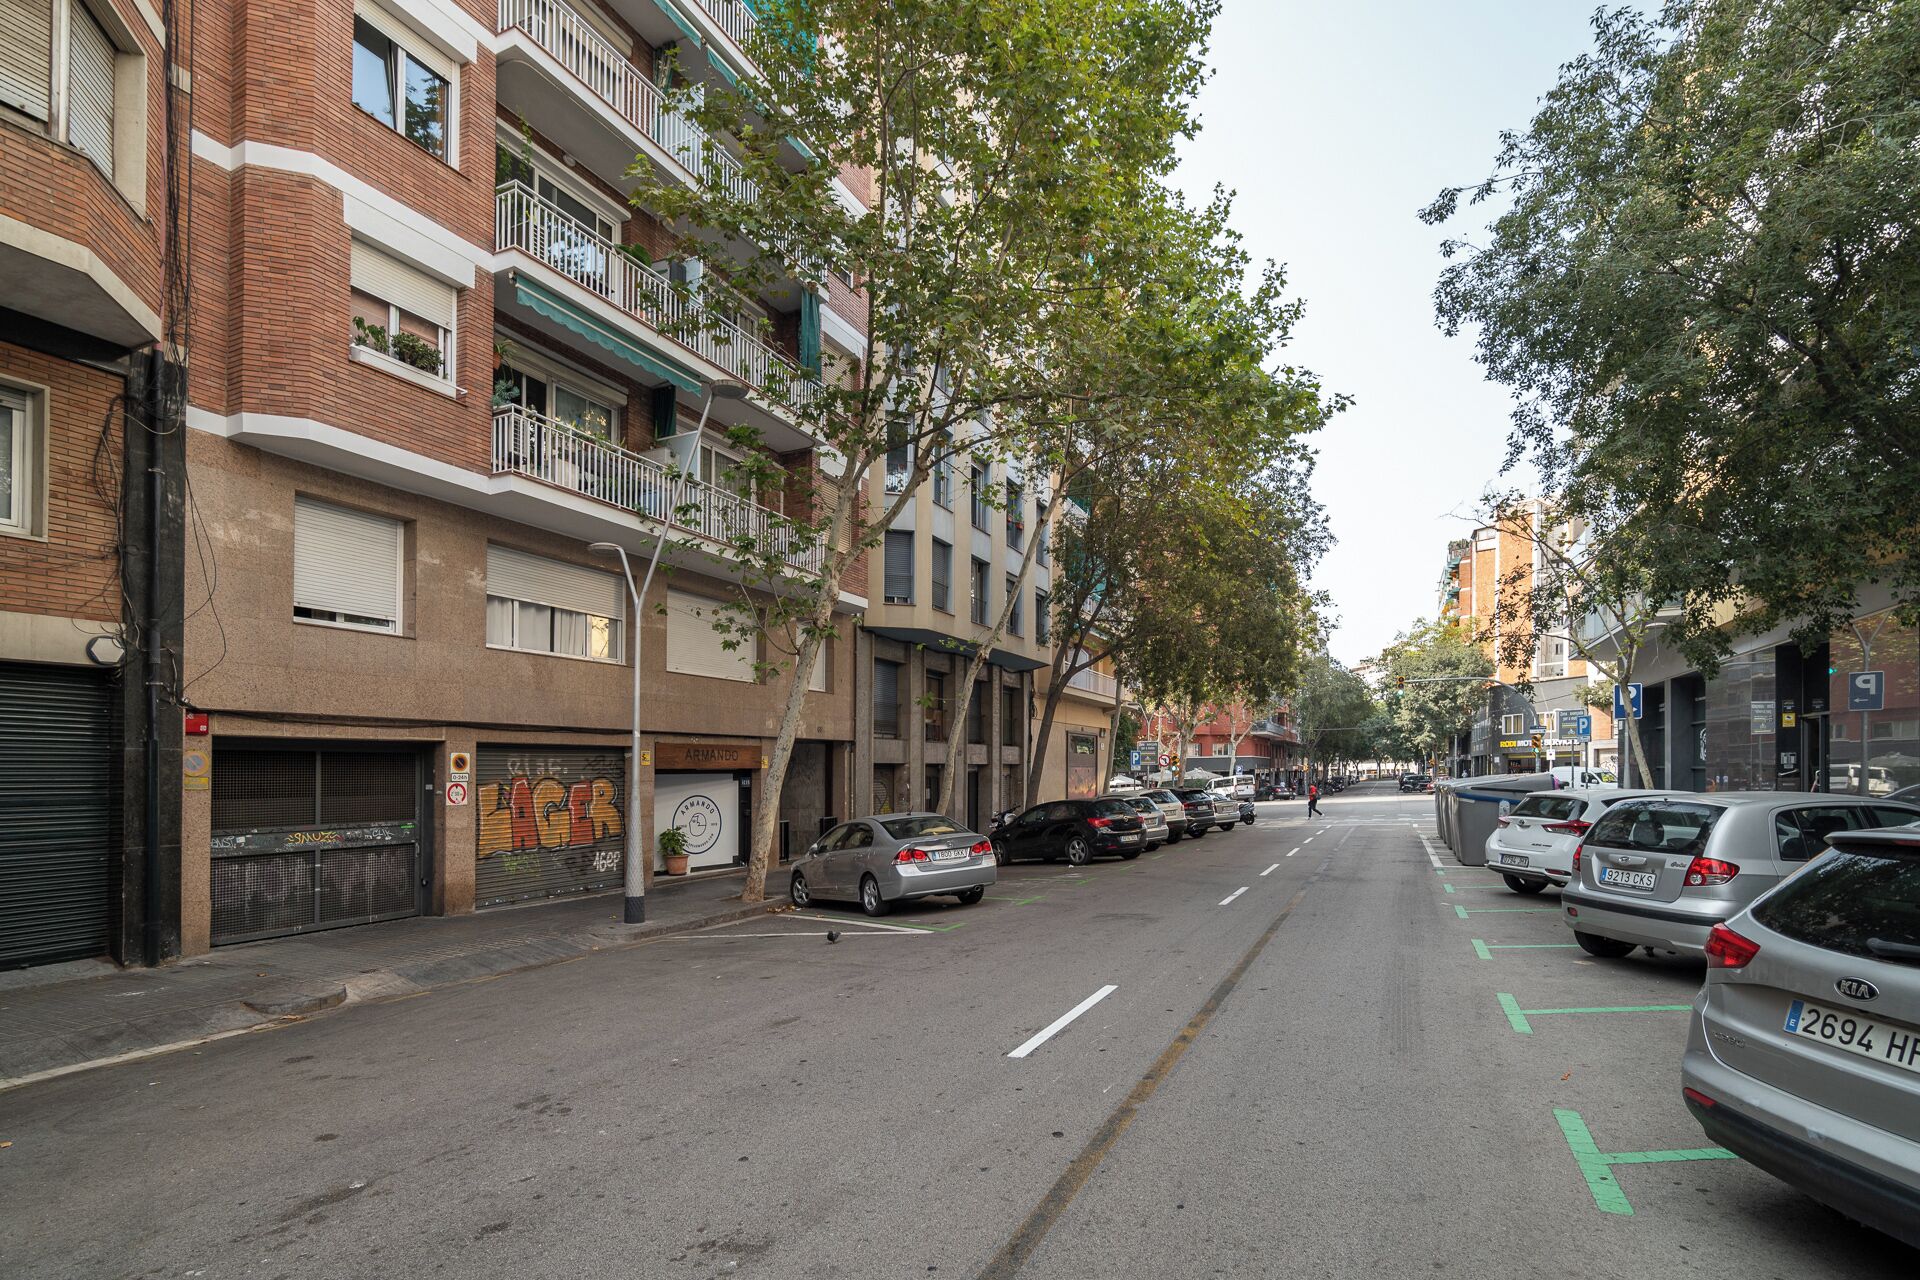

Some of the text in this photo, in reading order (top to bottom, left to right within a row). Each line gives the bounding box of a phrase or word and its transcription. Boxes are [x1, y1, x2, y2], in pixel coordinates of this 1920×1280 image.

[1579, 718, 1588, 734] P
[685, 749, 739, 761] ARMANDO
[1132, 752, 1140, 765] P
[681, 800, 715, 815] ARMANDO
[1607, 870, 1630, 883] 9213
[1633, 873, 1653, 886] CKS
[1839, 979, 1870, 999] KIA
[1802, 1008, 1874, 1053] 2694
